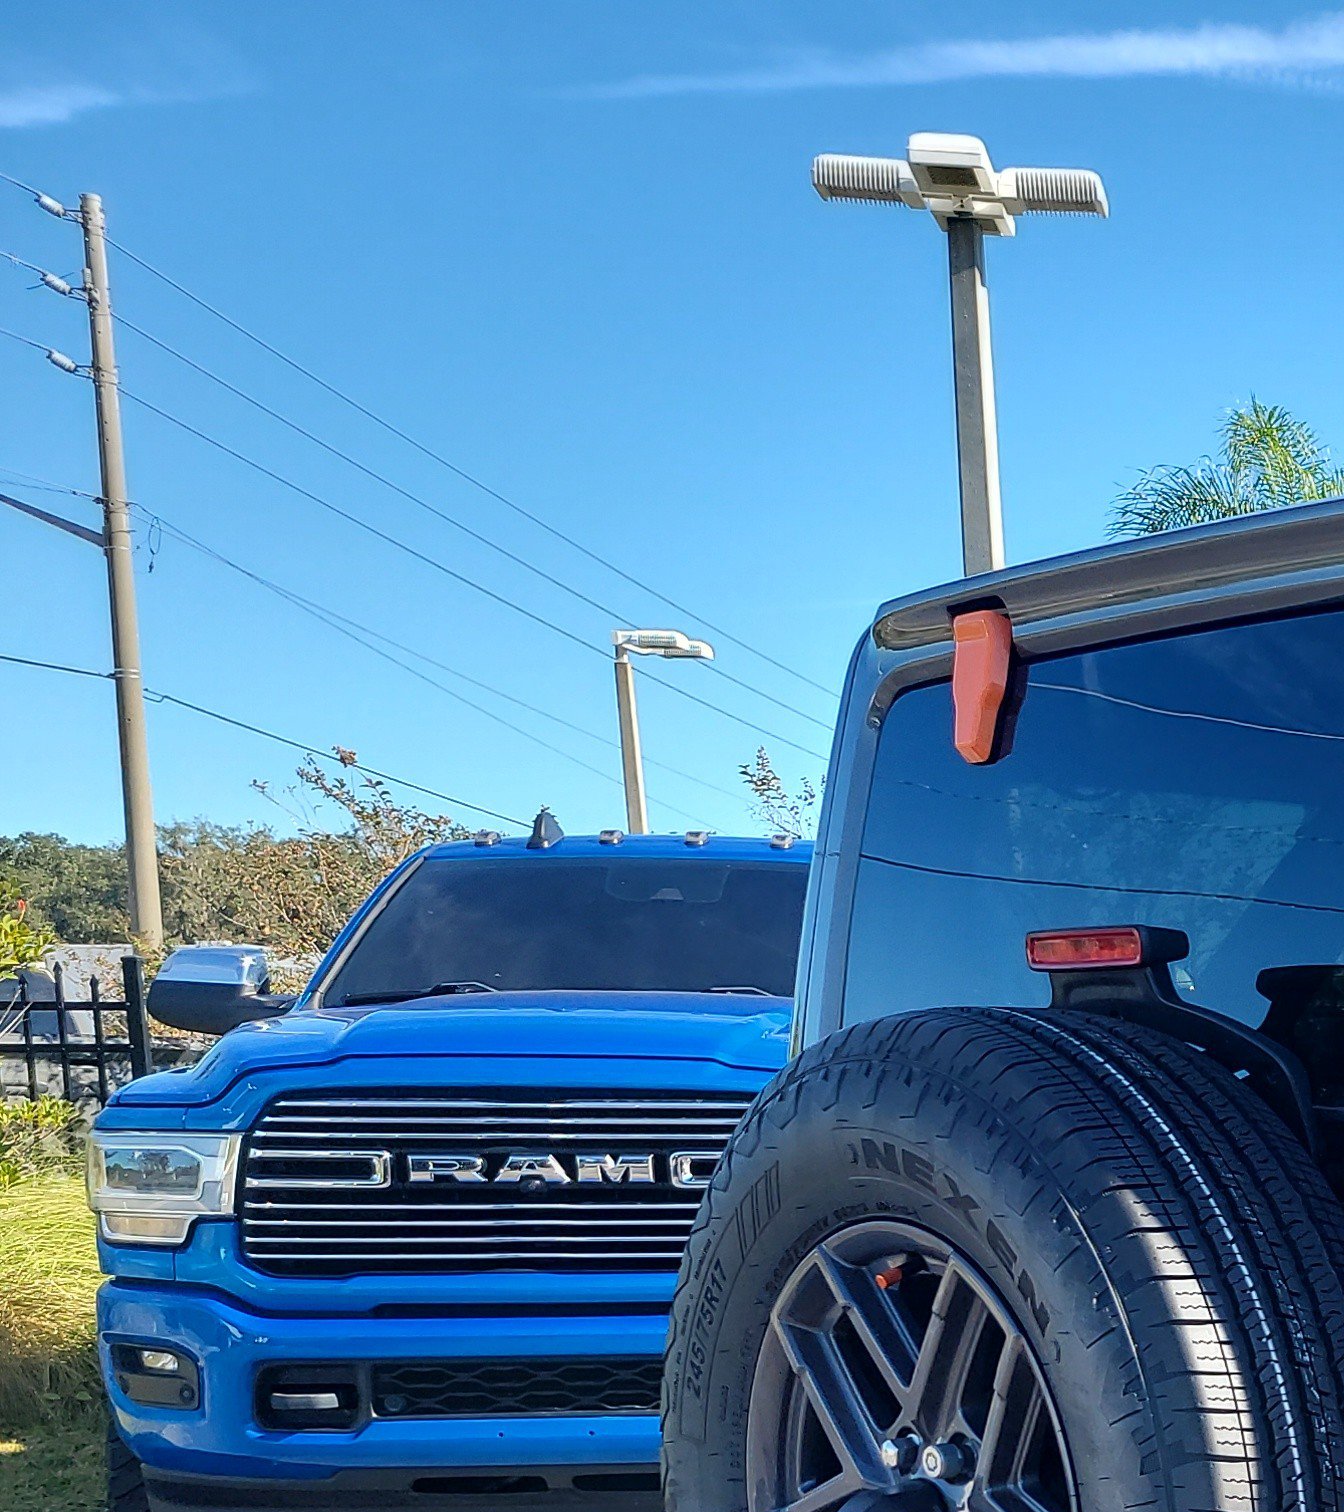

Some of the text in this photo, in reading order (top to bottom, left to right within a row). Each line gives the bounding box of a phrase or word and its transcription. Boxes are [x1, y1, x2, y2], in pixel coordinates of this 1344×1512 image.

[406, 1153, 656, 1183] RAM
[860, 1137, 1051, 1338] NEXEN
[686, 1257, 728, 1401] 245/75R17
